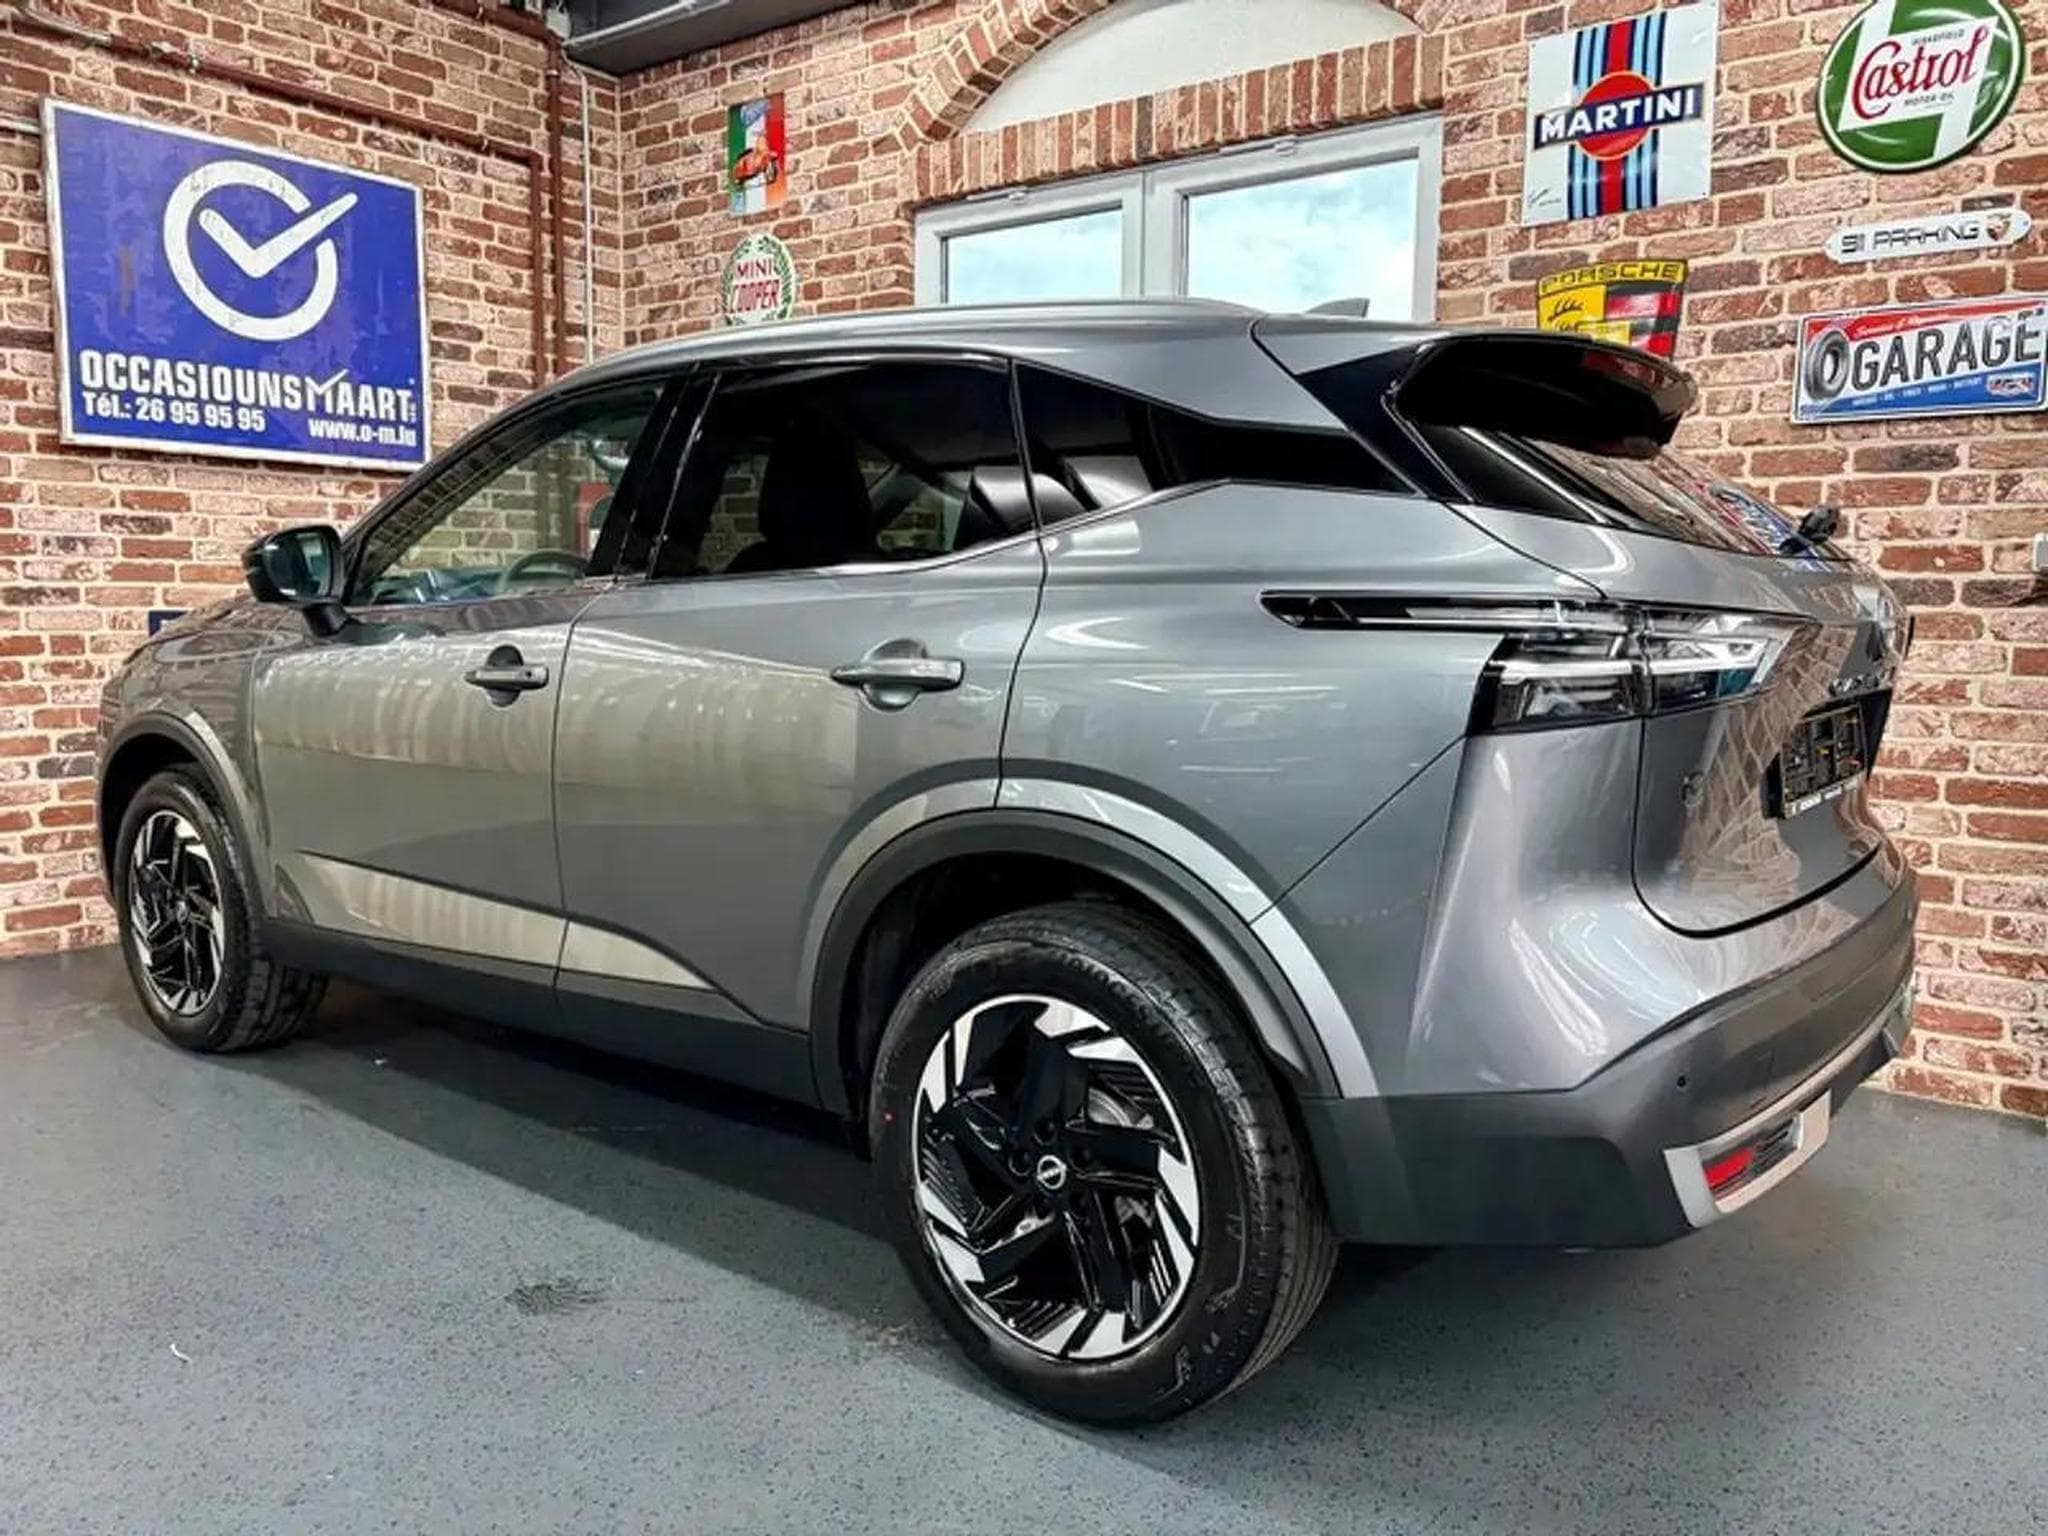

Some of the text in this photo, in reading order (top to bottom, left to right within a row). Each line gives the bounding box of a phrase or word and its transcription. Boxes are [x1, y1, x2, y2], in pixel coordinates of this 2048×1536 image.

[1853, 25, 1988, 120] Castrol
[1540, 88, 1694, 143] MARTINI
[1872, 220, 1980, 249] PARKING
[737, 257, 772, 278] MINI
[1543, 263, 1679, 293] PORSCHE
[730, 279, 780, 314] COOPER
[1851, 308, 2044, 391] GARAGE
[135, 396, 166, 423] 26
[169, 401, 200, 426] 95
[204, 403, 234, 429] 95
[237, 406, 266, 432] 95
[308, 418, 417, 447] www.o-m.lu
